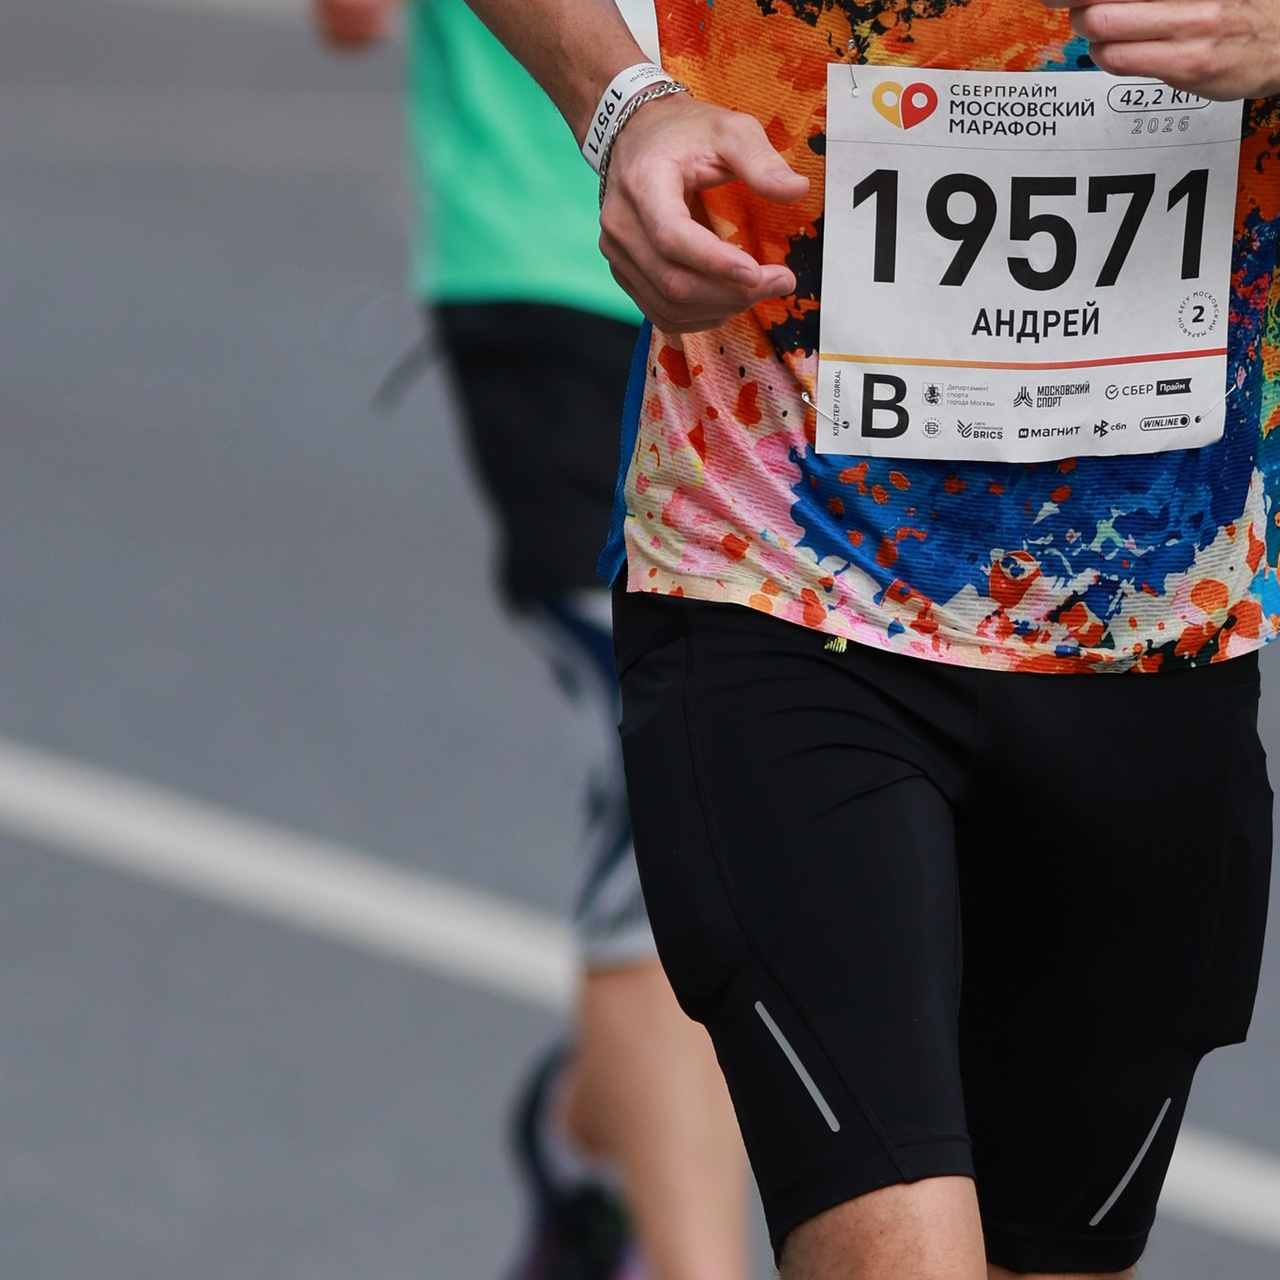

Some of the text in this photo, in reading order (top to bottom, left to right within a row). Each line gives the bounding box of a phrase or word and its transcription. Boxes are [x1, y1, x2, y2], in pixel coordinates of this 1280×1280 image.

[950, 84, 1057, 98] СБЕРПРАЙМ
[1120, 89, 1163, 108] 42,2
[949, 98, 1094, 118] МОСКОВСКИЙ
[949, 119, 1056, 136] МАРАФОН
[1131, 116, 1189, 134] 2026
[853, 169, 1209, 291] 19571
[972, 301, 1099, 343] АНДРЕЙ
[1192, 306, 1204, 323] 2
[947, 384, 989, 394] Департамент
[1037, 381, 1090, 396] МОСКОВСКИЙ
[1122, 383, 1186, 396] СБЕР Прайм
[1037, 397, 1062, 408] СПОРТ
[1143, 417, 1179, 428] WINLINE
[973, 431, 1003, 439] BRICS
[1031, 426, 1081, 438] магнит
